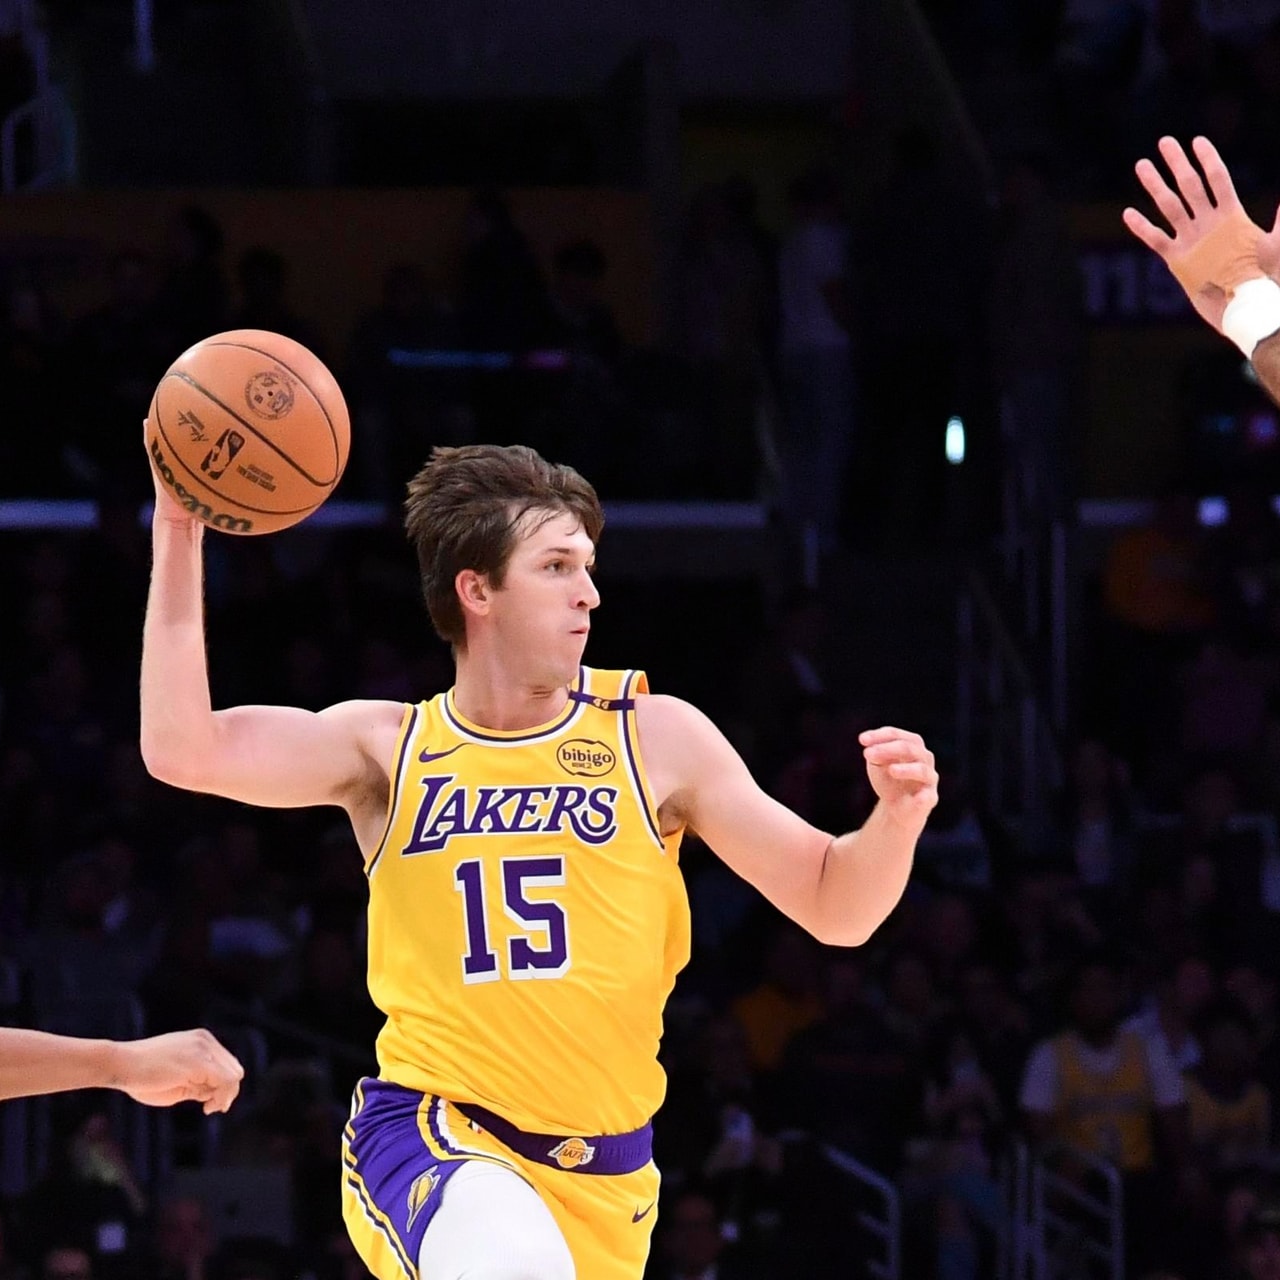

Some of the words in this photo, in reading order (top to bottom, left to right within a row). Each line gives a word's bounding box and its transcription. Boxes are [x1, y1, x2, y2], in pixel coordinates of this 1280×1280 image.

[562, 748, 613, 767] bibigo
[400, 774, 619, 856] LAKERS
[454, 855, 572, 984] 15
